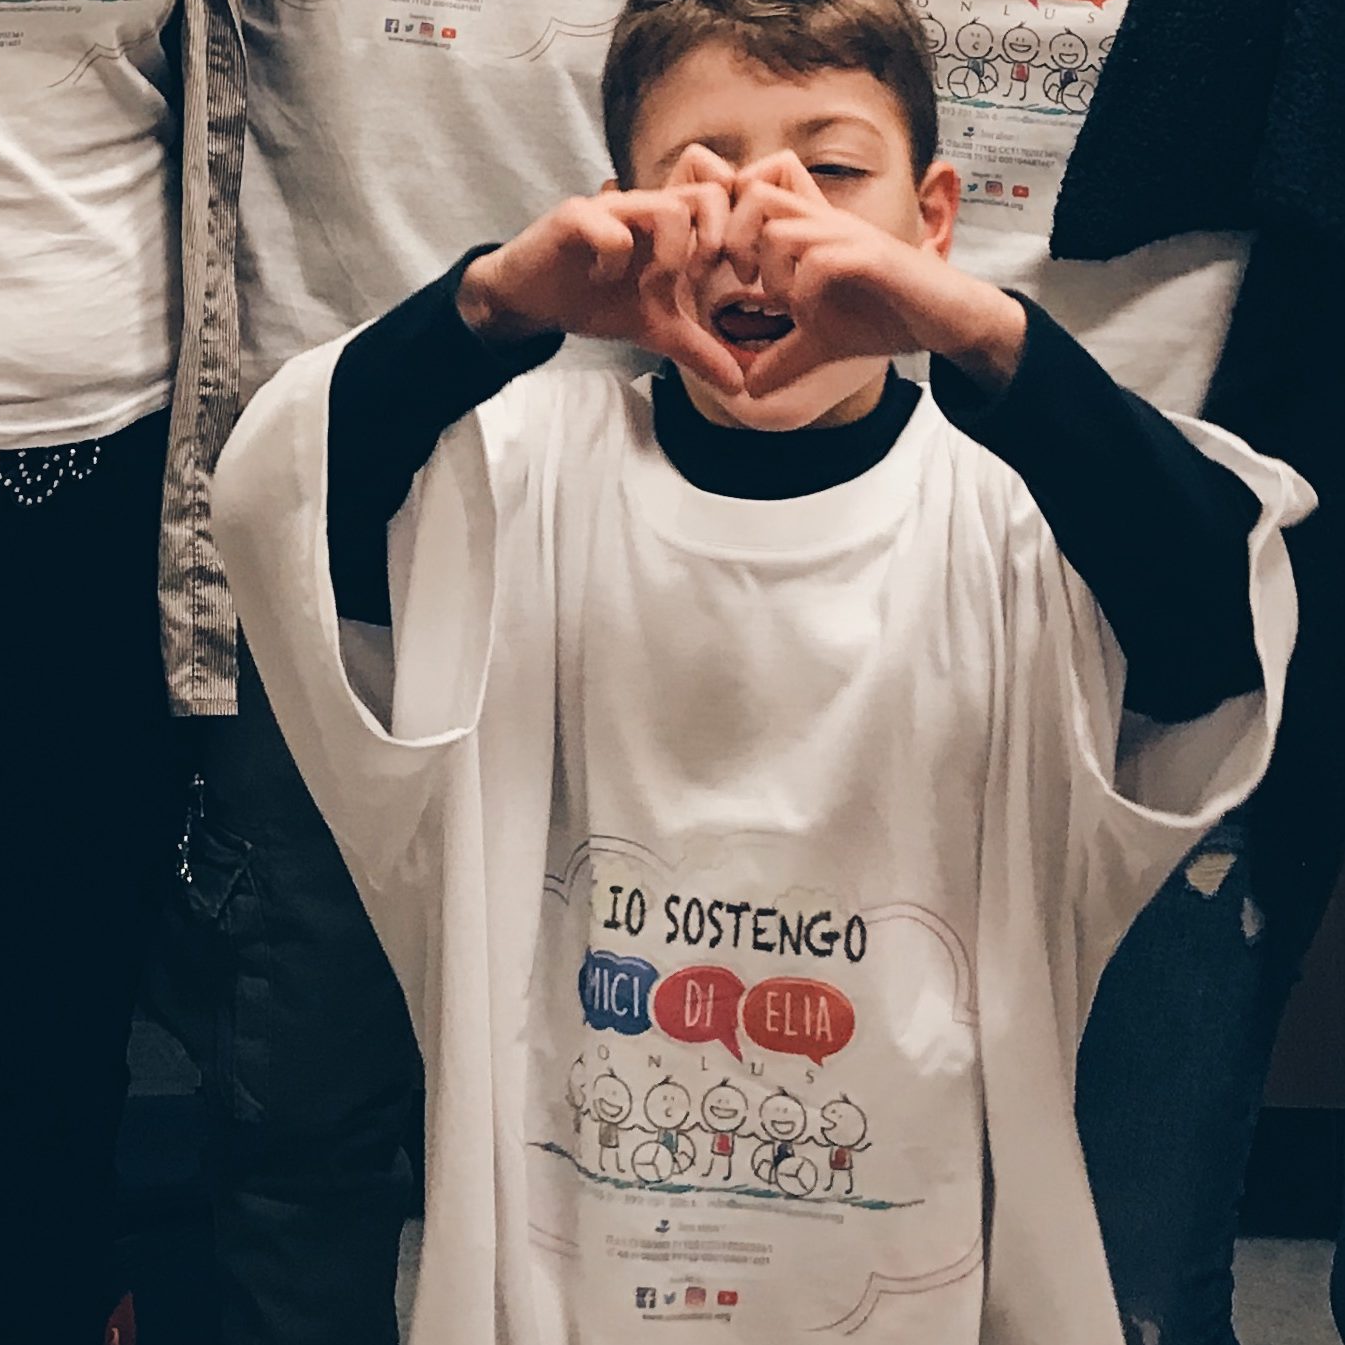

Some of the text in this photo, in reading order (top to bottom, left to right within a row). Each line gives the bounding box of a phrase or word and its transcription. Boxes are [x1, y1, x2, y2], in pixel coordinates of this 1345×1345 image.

[664, 894, 867, 964] SOSTENGO
[685, 979, 714, 1028] DI
[765, 991, 833, 1043] ELIA
[597, 1044, 814, 1085] ONLUS
